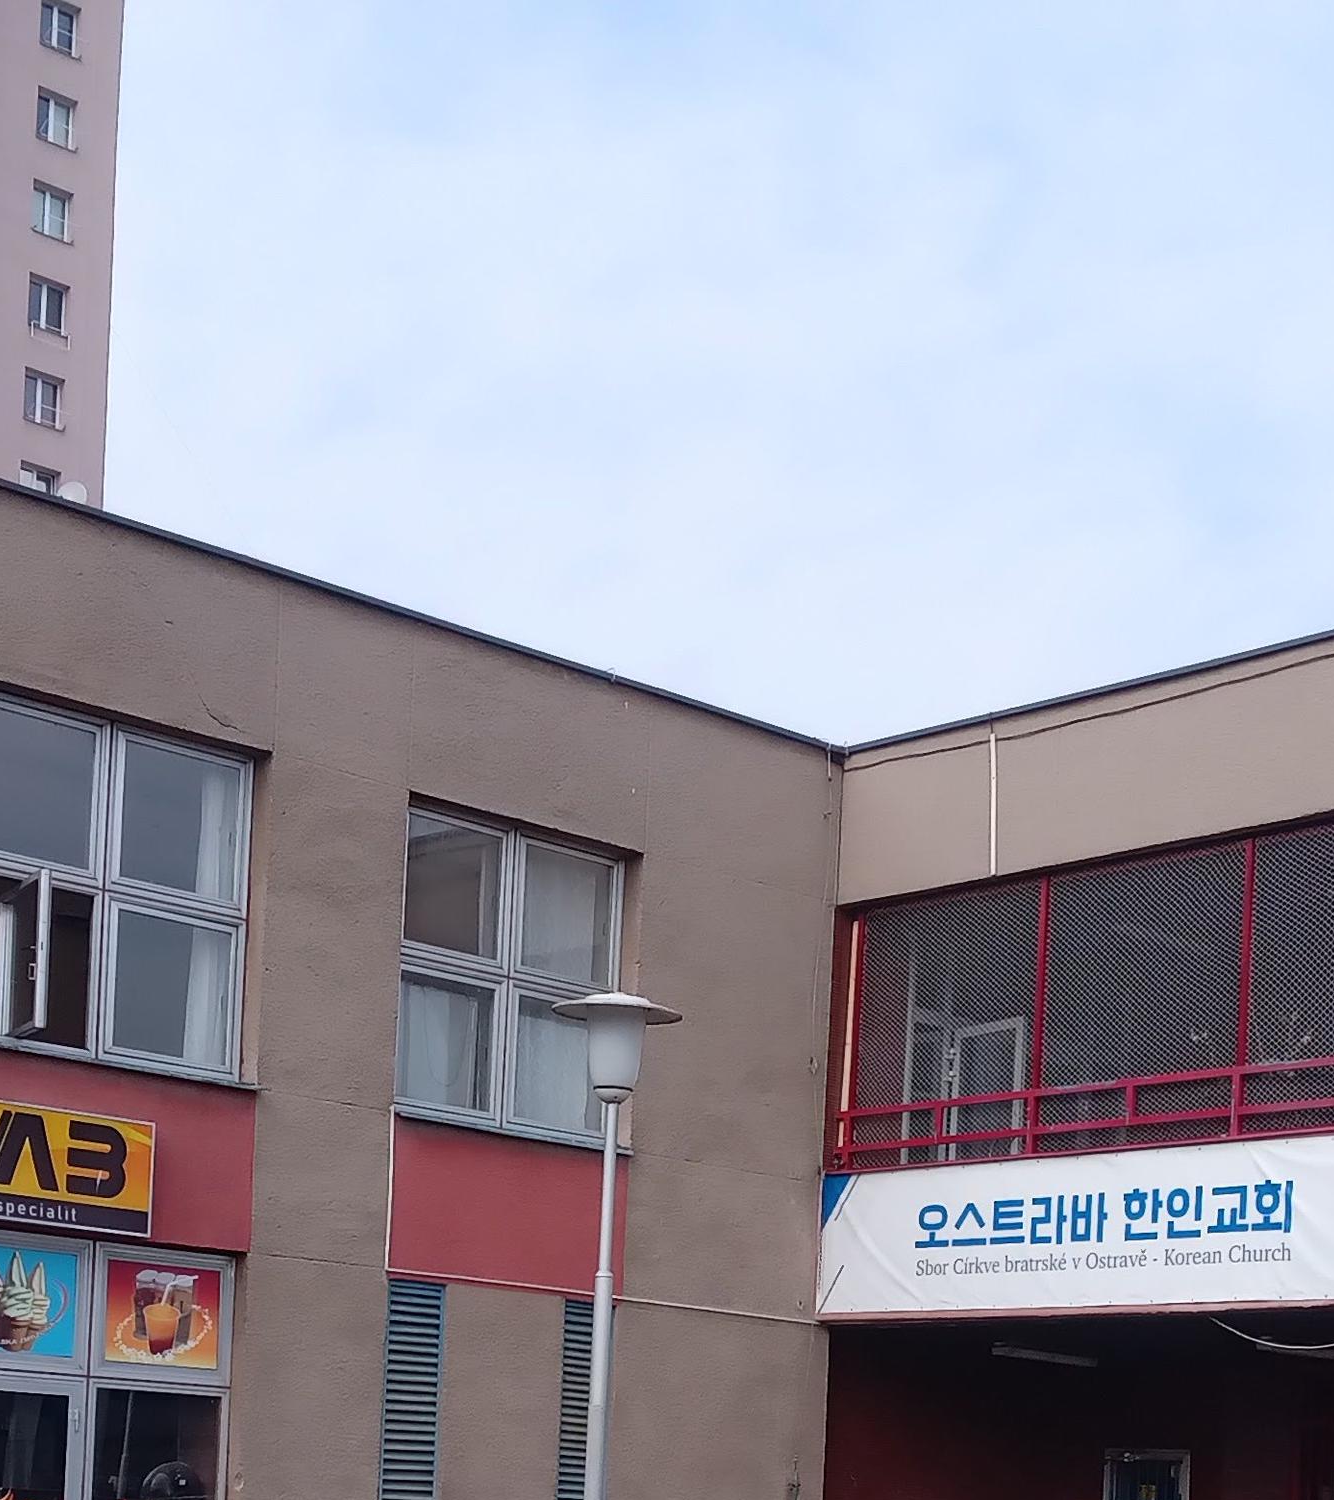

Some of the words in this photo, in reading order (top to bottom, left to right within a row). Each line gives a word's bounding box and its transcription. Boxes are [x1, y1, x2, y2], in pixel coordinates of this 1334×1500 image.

[914, 1192, 1108, 1249] 오스트라바
[1123, 1179, 1294, 1242] 한인교회
[915, 1258, 950, 1277] Sbor
[952, 1256, 1000, 1276] Církve
[1004, 1253, 1067, 1273] bratrské
[1072, 1257, 1082, 1270] v
[1085, 1249, 1147, 1271] Ostravě
[1164, 1246, 1223, 1267] Korean
[1227, 1242, 1292, 1264] Church
